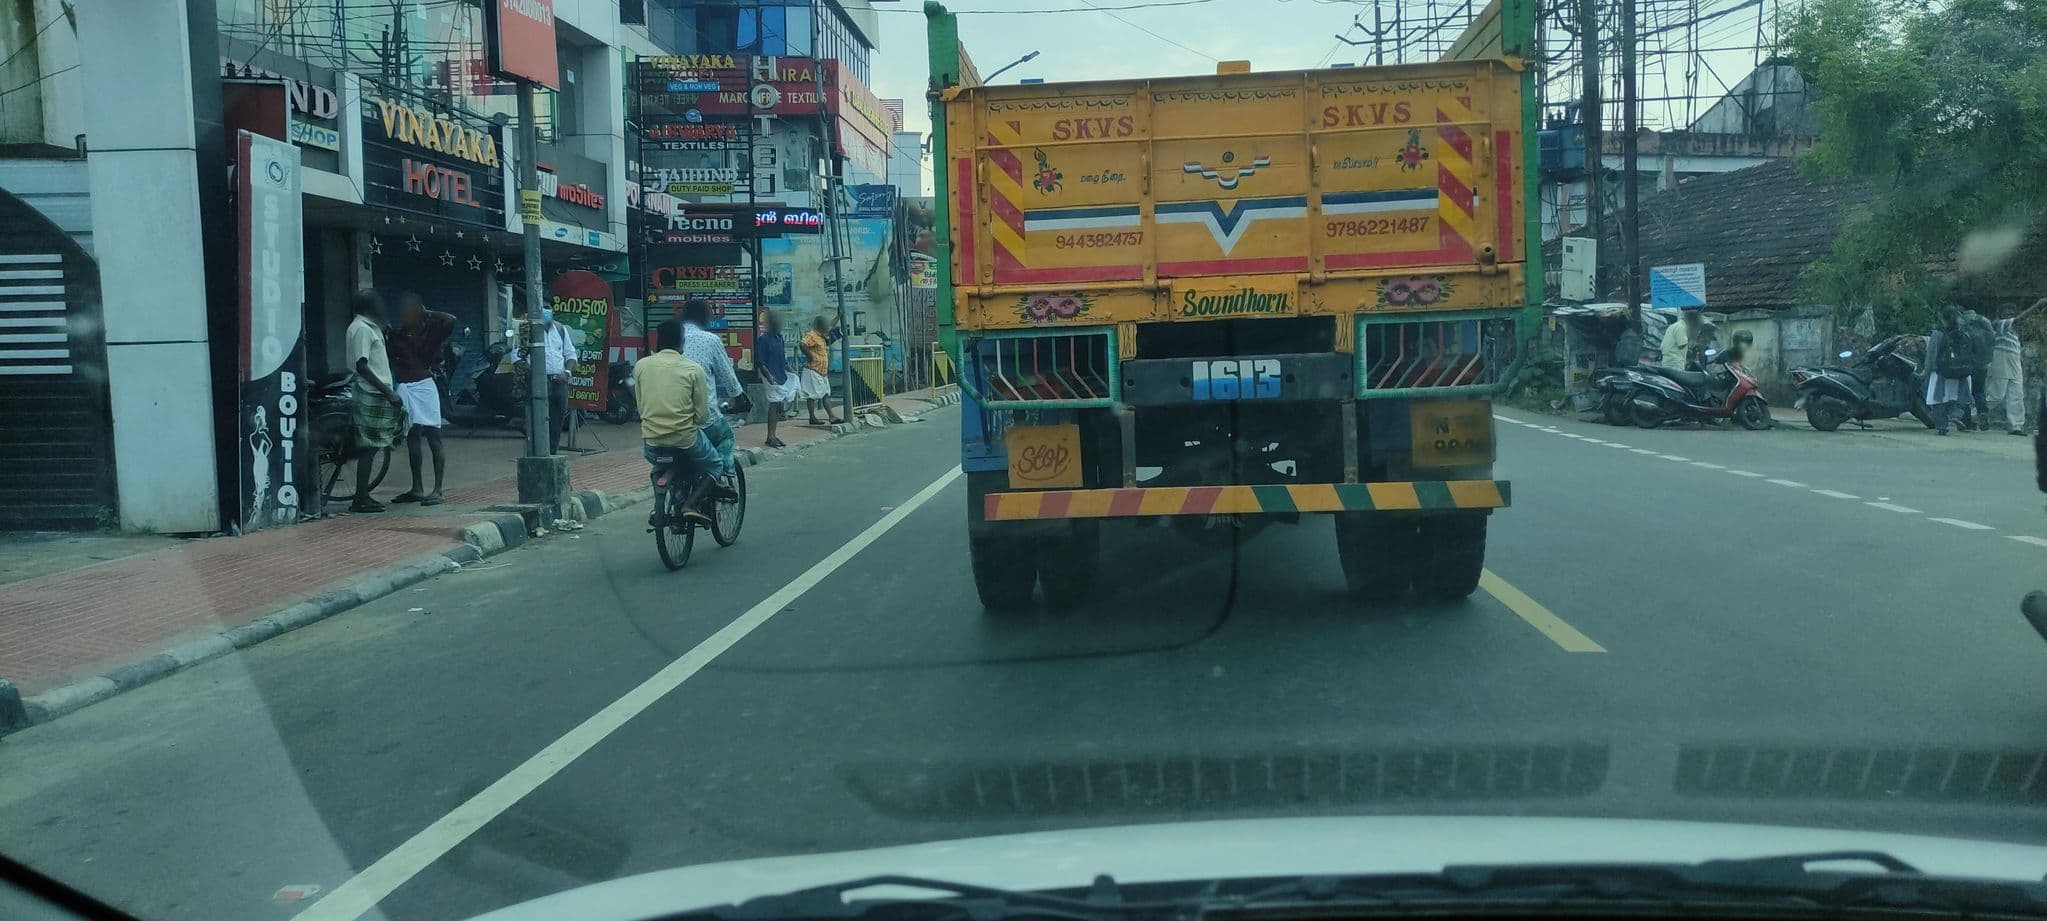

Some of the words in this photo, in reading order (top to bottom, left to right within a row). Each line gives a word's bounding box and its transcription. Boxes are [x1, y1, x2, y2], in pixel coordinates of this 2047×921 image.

[649, 54, 736, 69] VINAYAKA
[291, 125, 337, 146] SHOP
[379, 99, 500, 168] VINAYAKA
[751, 55, 778, 194] HOTEL
[662, 141, 725, 150] TEXTILES
[401, 158, 480, 207] HOTEL
[651, 167, 739, 193] JAIHIND
[557, 182, 605, 210] mobiles
[667, 213, 733, 231] Tecno
[1326, 217, 1430, 238] 9786221487
[668, 235, 731, 243] mobiles
[1055, 231, 1144, 250] 9443824757
[262, 193, 283, 363] STUDIO
[1180, 286, 1292, 316] Soundhorn
[1193, 359, 1281, 401] 1613
[1018, 443, 1069, 474] Stop
